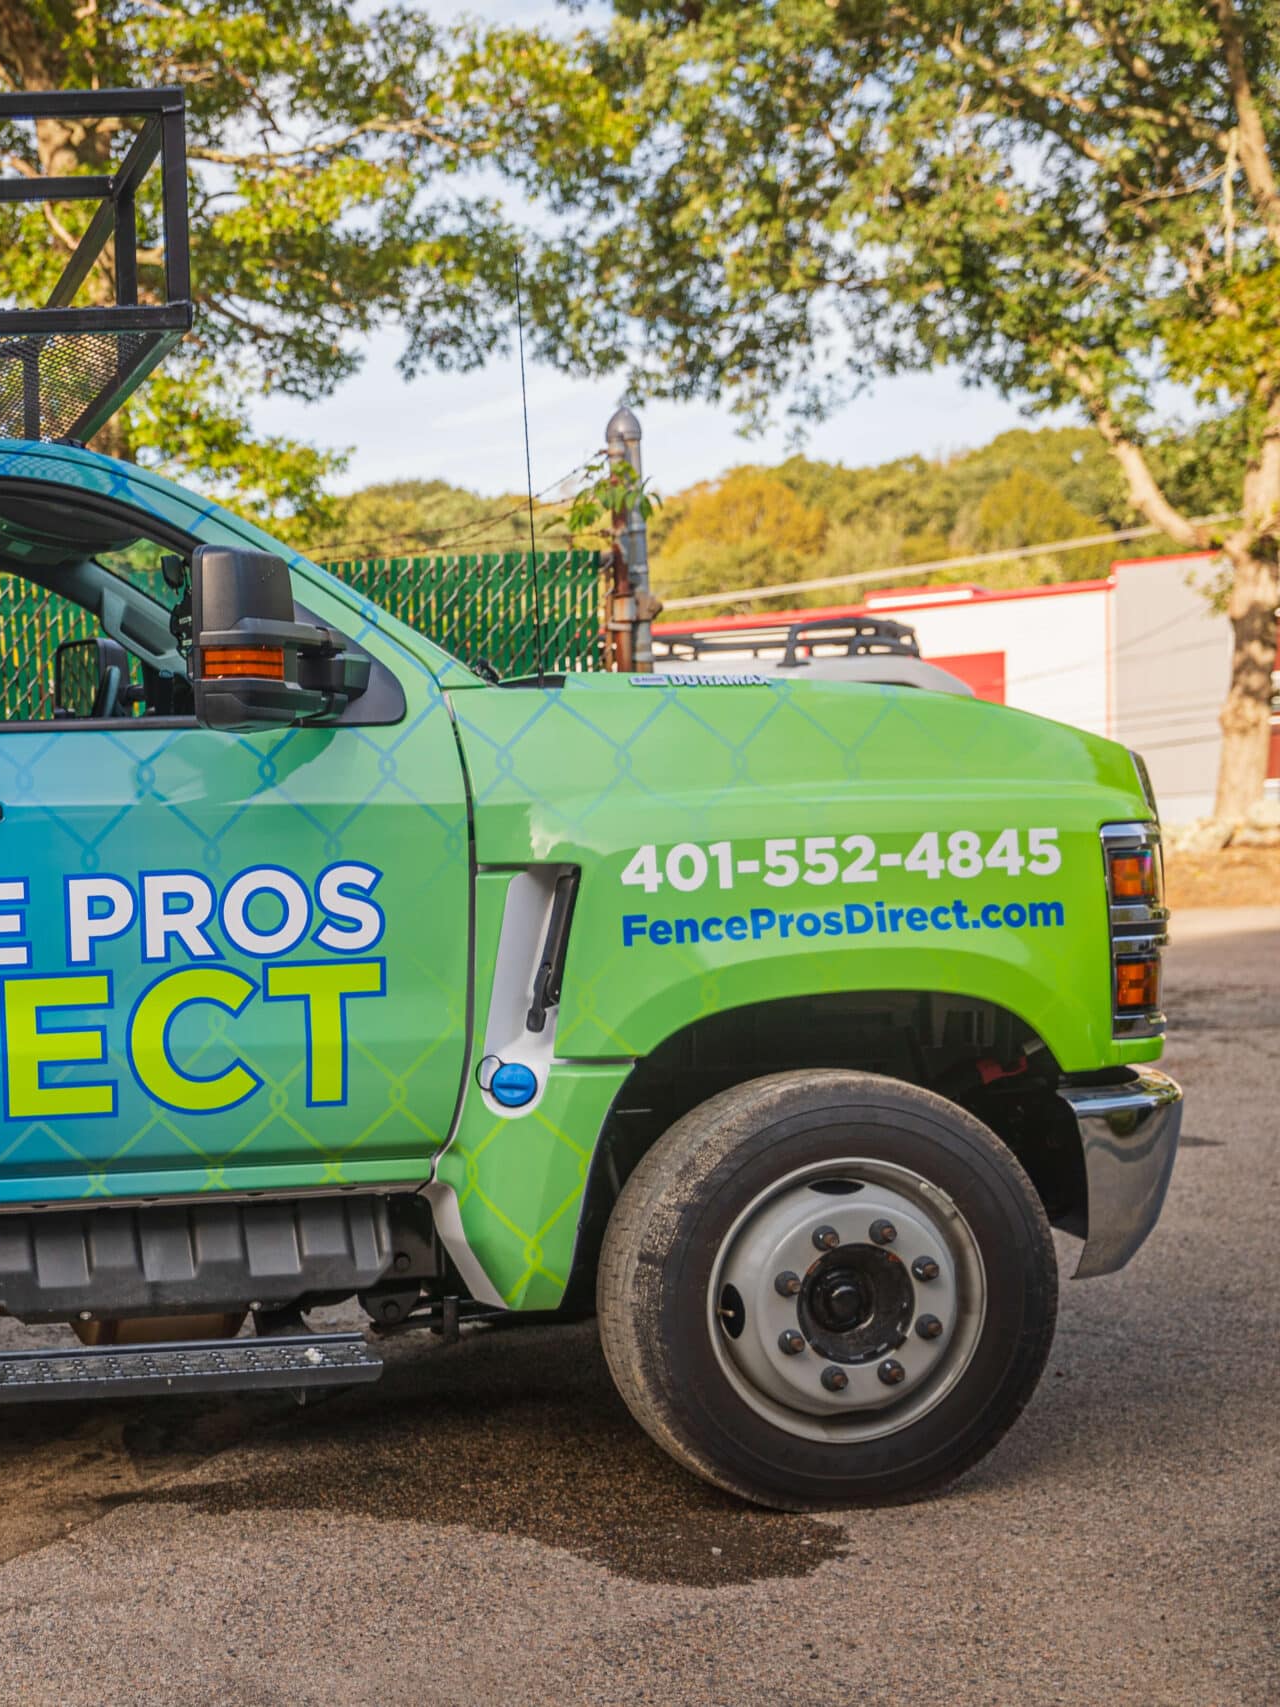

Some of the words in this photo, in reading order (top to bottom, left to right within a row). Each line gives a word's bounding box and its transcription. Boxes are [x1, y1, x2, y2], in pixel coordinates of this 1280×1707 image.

[620, 827, 1063, 893] 401-552-4845
[67, 864, 381, 963] PROS
[622, 899, 1065, 947] FenceProsDirect.com
